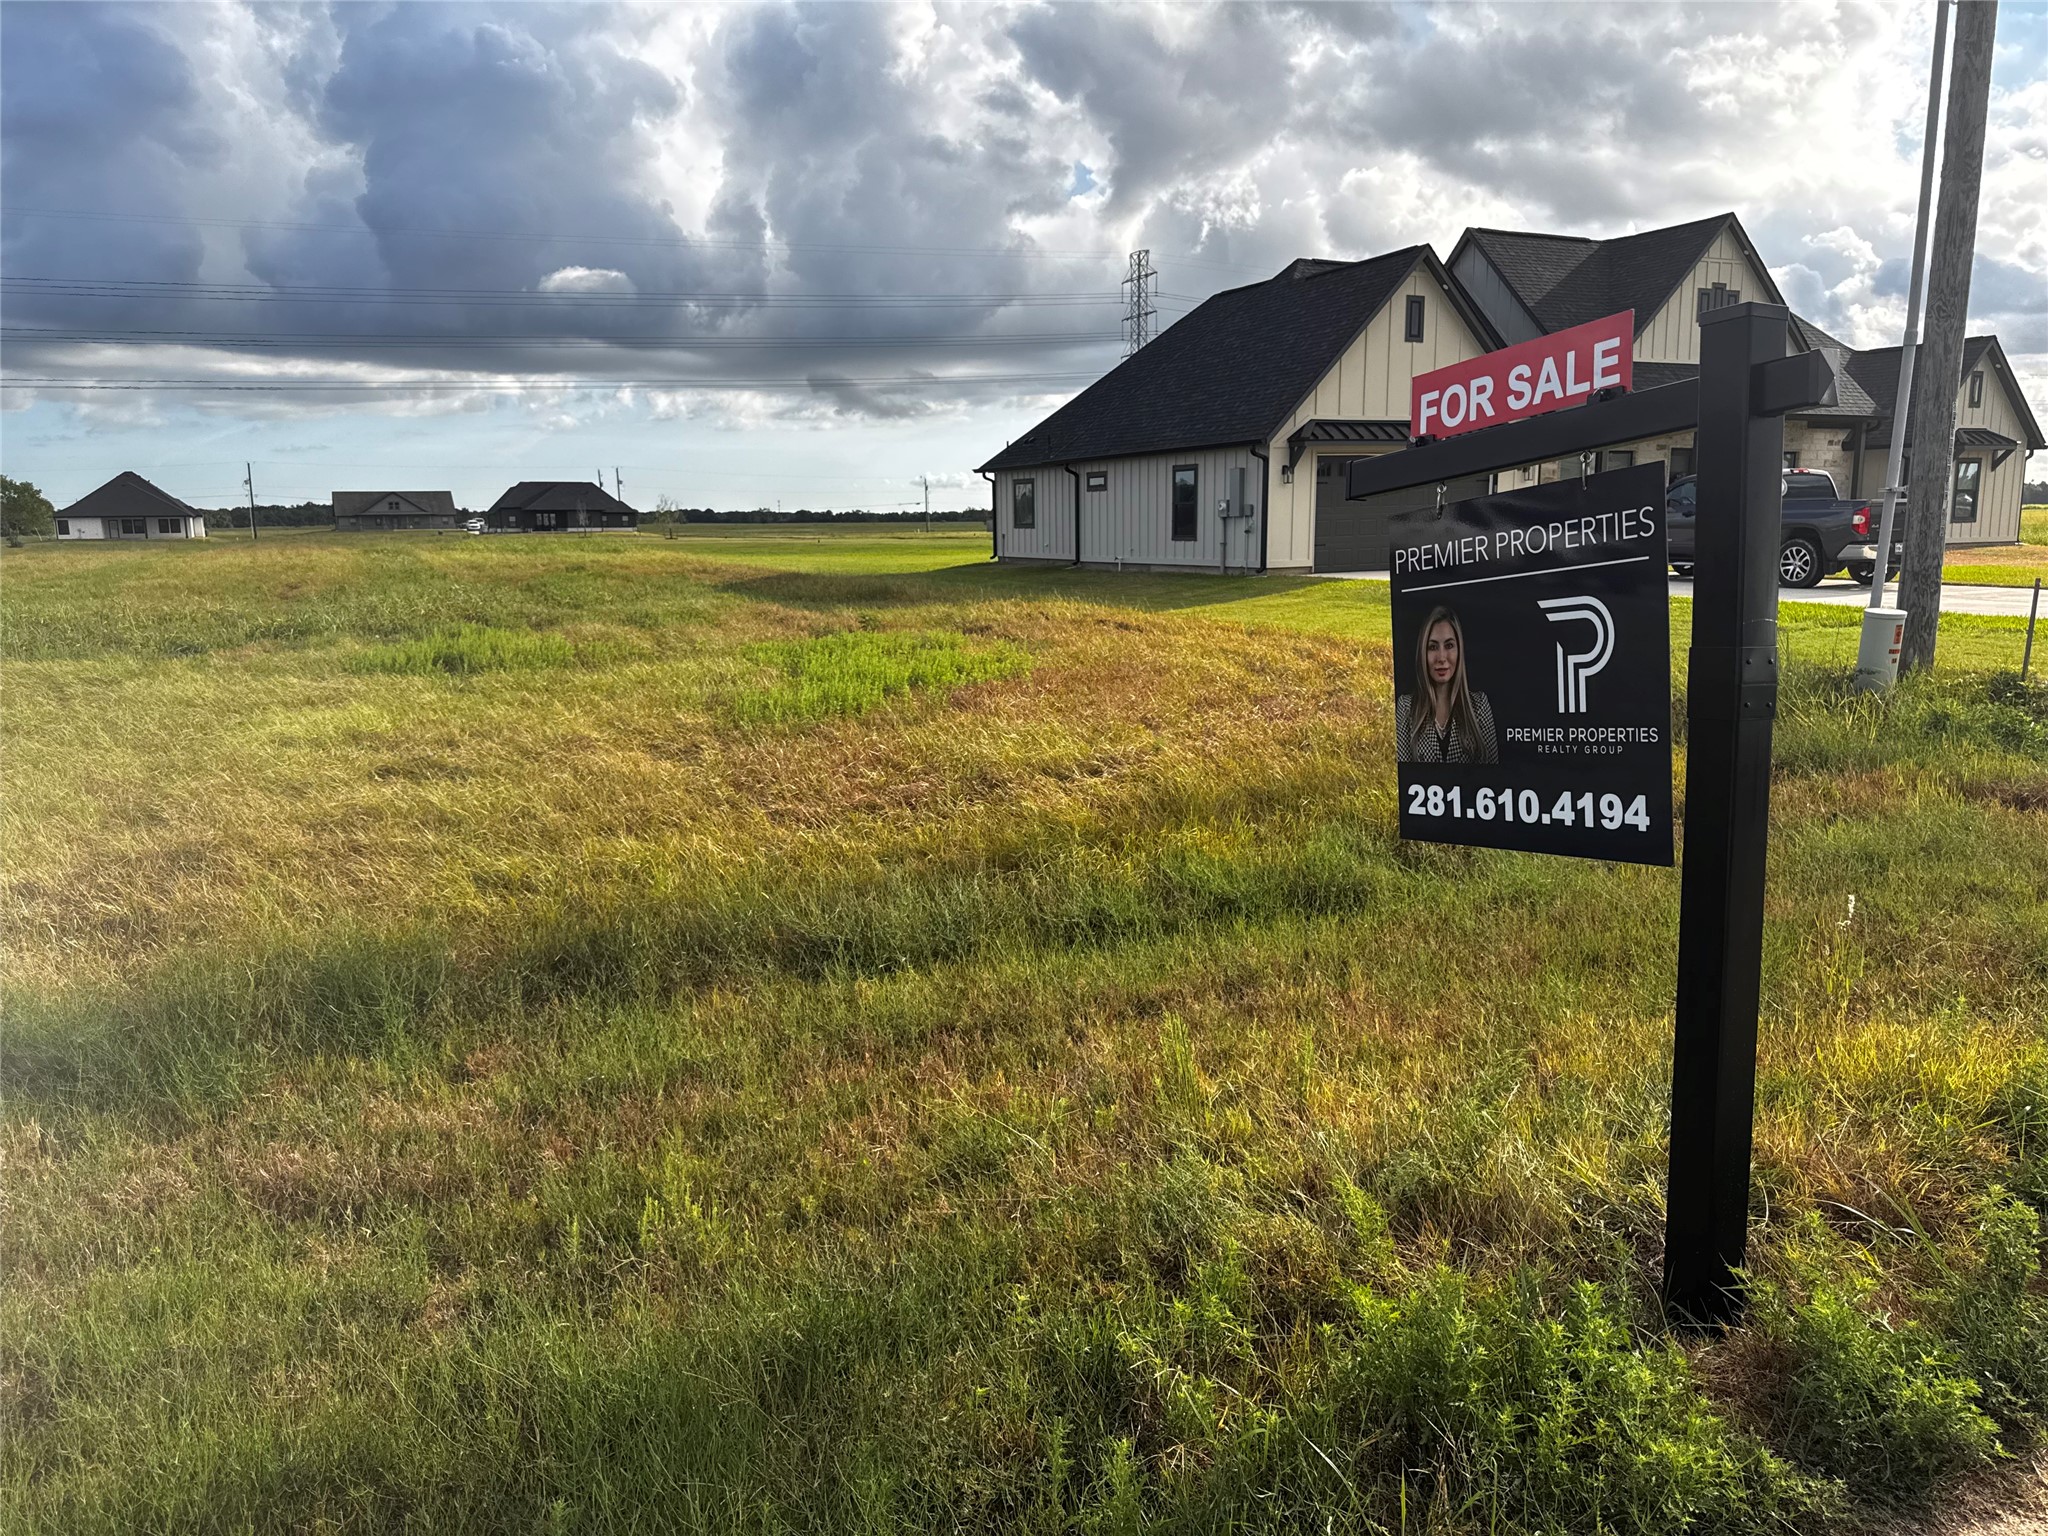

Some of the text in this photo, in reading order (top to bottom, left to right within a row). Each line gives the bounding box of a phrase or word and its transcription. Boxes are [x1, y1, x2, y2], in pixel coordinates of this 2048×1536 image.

[1419, 336, 1621, 435] FOR SALE
[1395, 506, 1655, 575] PREMIER PROPERTIES
[1506, 727, 1659, 743] PREMIER PROPERTIES
[1538, 745, 1623, 755] REALTY GROUP
[1407, 784, 1650, 832] 281.610.4194
